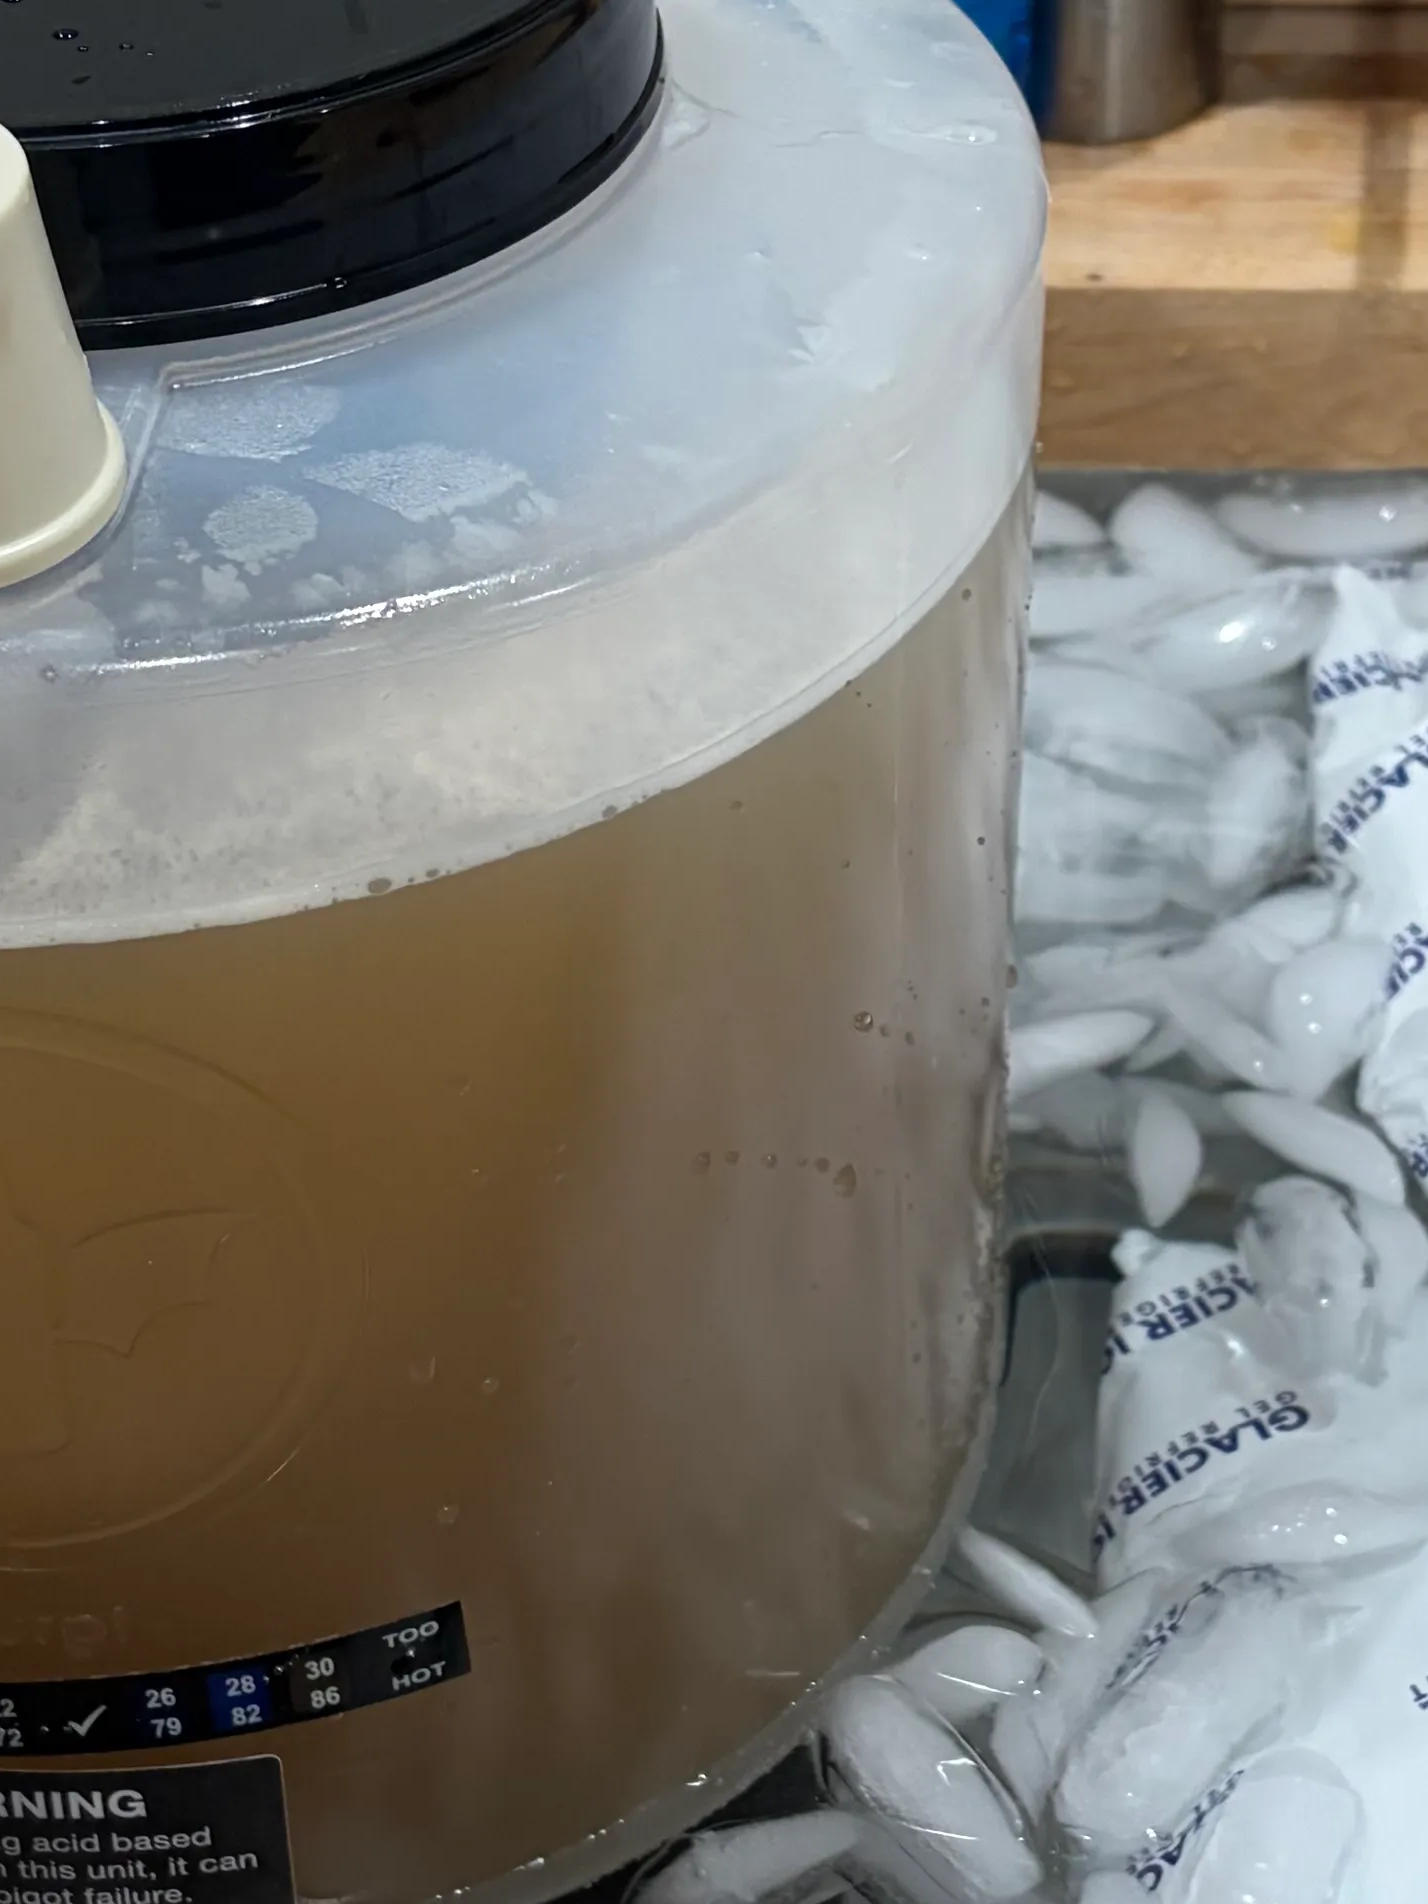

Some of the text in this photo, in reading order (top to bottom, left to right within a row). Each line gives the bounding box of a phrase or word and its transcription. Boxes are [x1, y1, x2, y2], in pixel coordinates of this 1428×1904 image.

[1121, 1404, 1311, 1516] GLACIER
[145, 1687, 176, 1709] 26
[225, 1674, 256, 1698] 28
[305, 1657, 335, 1681] 30
[382, 1620, 440, 1649] TOO
[150, 1717, 182, 1739] 79
[231, 1704, 263, 1727] 82
[310, 1686, 341, 1710] 86
[391, 1661, 447, 1691] HOT
[18, 1859, 77, 1881] this
[87, 1859, 157, 1881] unit,
[167, 1856, 189, 1877] it
[198, 1851, 259, 1874] can
[32, 1832, 101, 1853] acid
[111, 1825, 213, 1853] based
